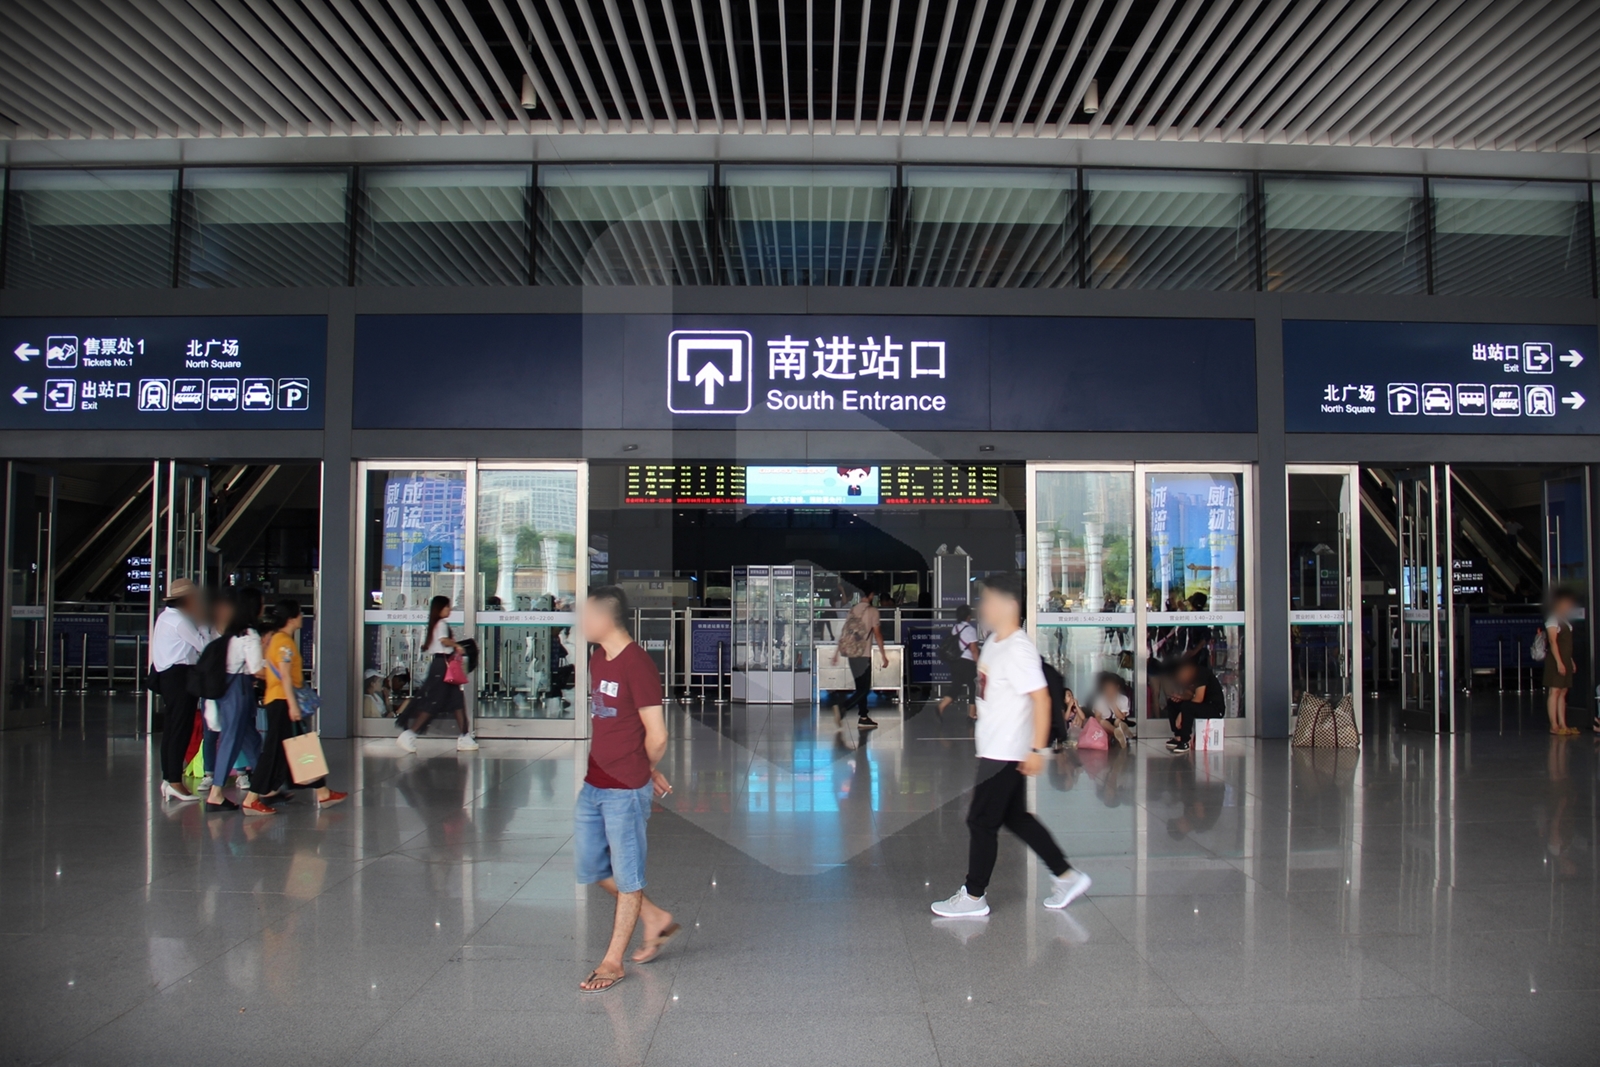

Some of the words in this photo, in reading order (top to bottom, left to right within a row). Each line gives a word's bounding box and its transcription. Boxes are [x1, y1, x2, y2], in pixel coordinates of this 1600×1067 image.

[186, 338, 240, 357] 北广场
[1472, 343, 1519, 362] 出站口
[83, 357, 112, 367] Tickets
[113, 358, 133, 367] No.1
[185, 359, 210, 369] North
[210, 359, 242, 370] Square
[767, 334, 946, 381] 南进站口
[1503, 363, 1520, 373] Exit
[81, 380, 131, 399] 出站口
[181, 385, 196, 393] BRT
[1323, 383, 1376, 403] 北广场
[81, 400, 98, 410] Exit
[767, 389, 835, 411] South
[842, 389, 947, 411] Entrance
[1320, 404, 1344, 413] North
[1345, 404, 1376, 415] Square
[386, 506, 425, 529] 物流
